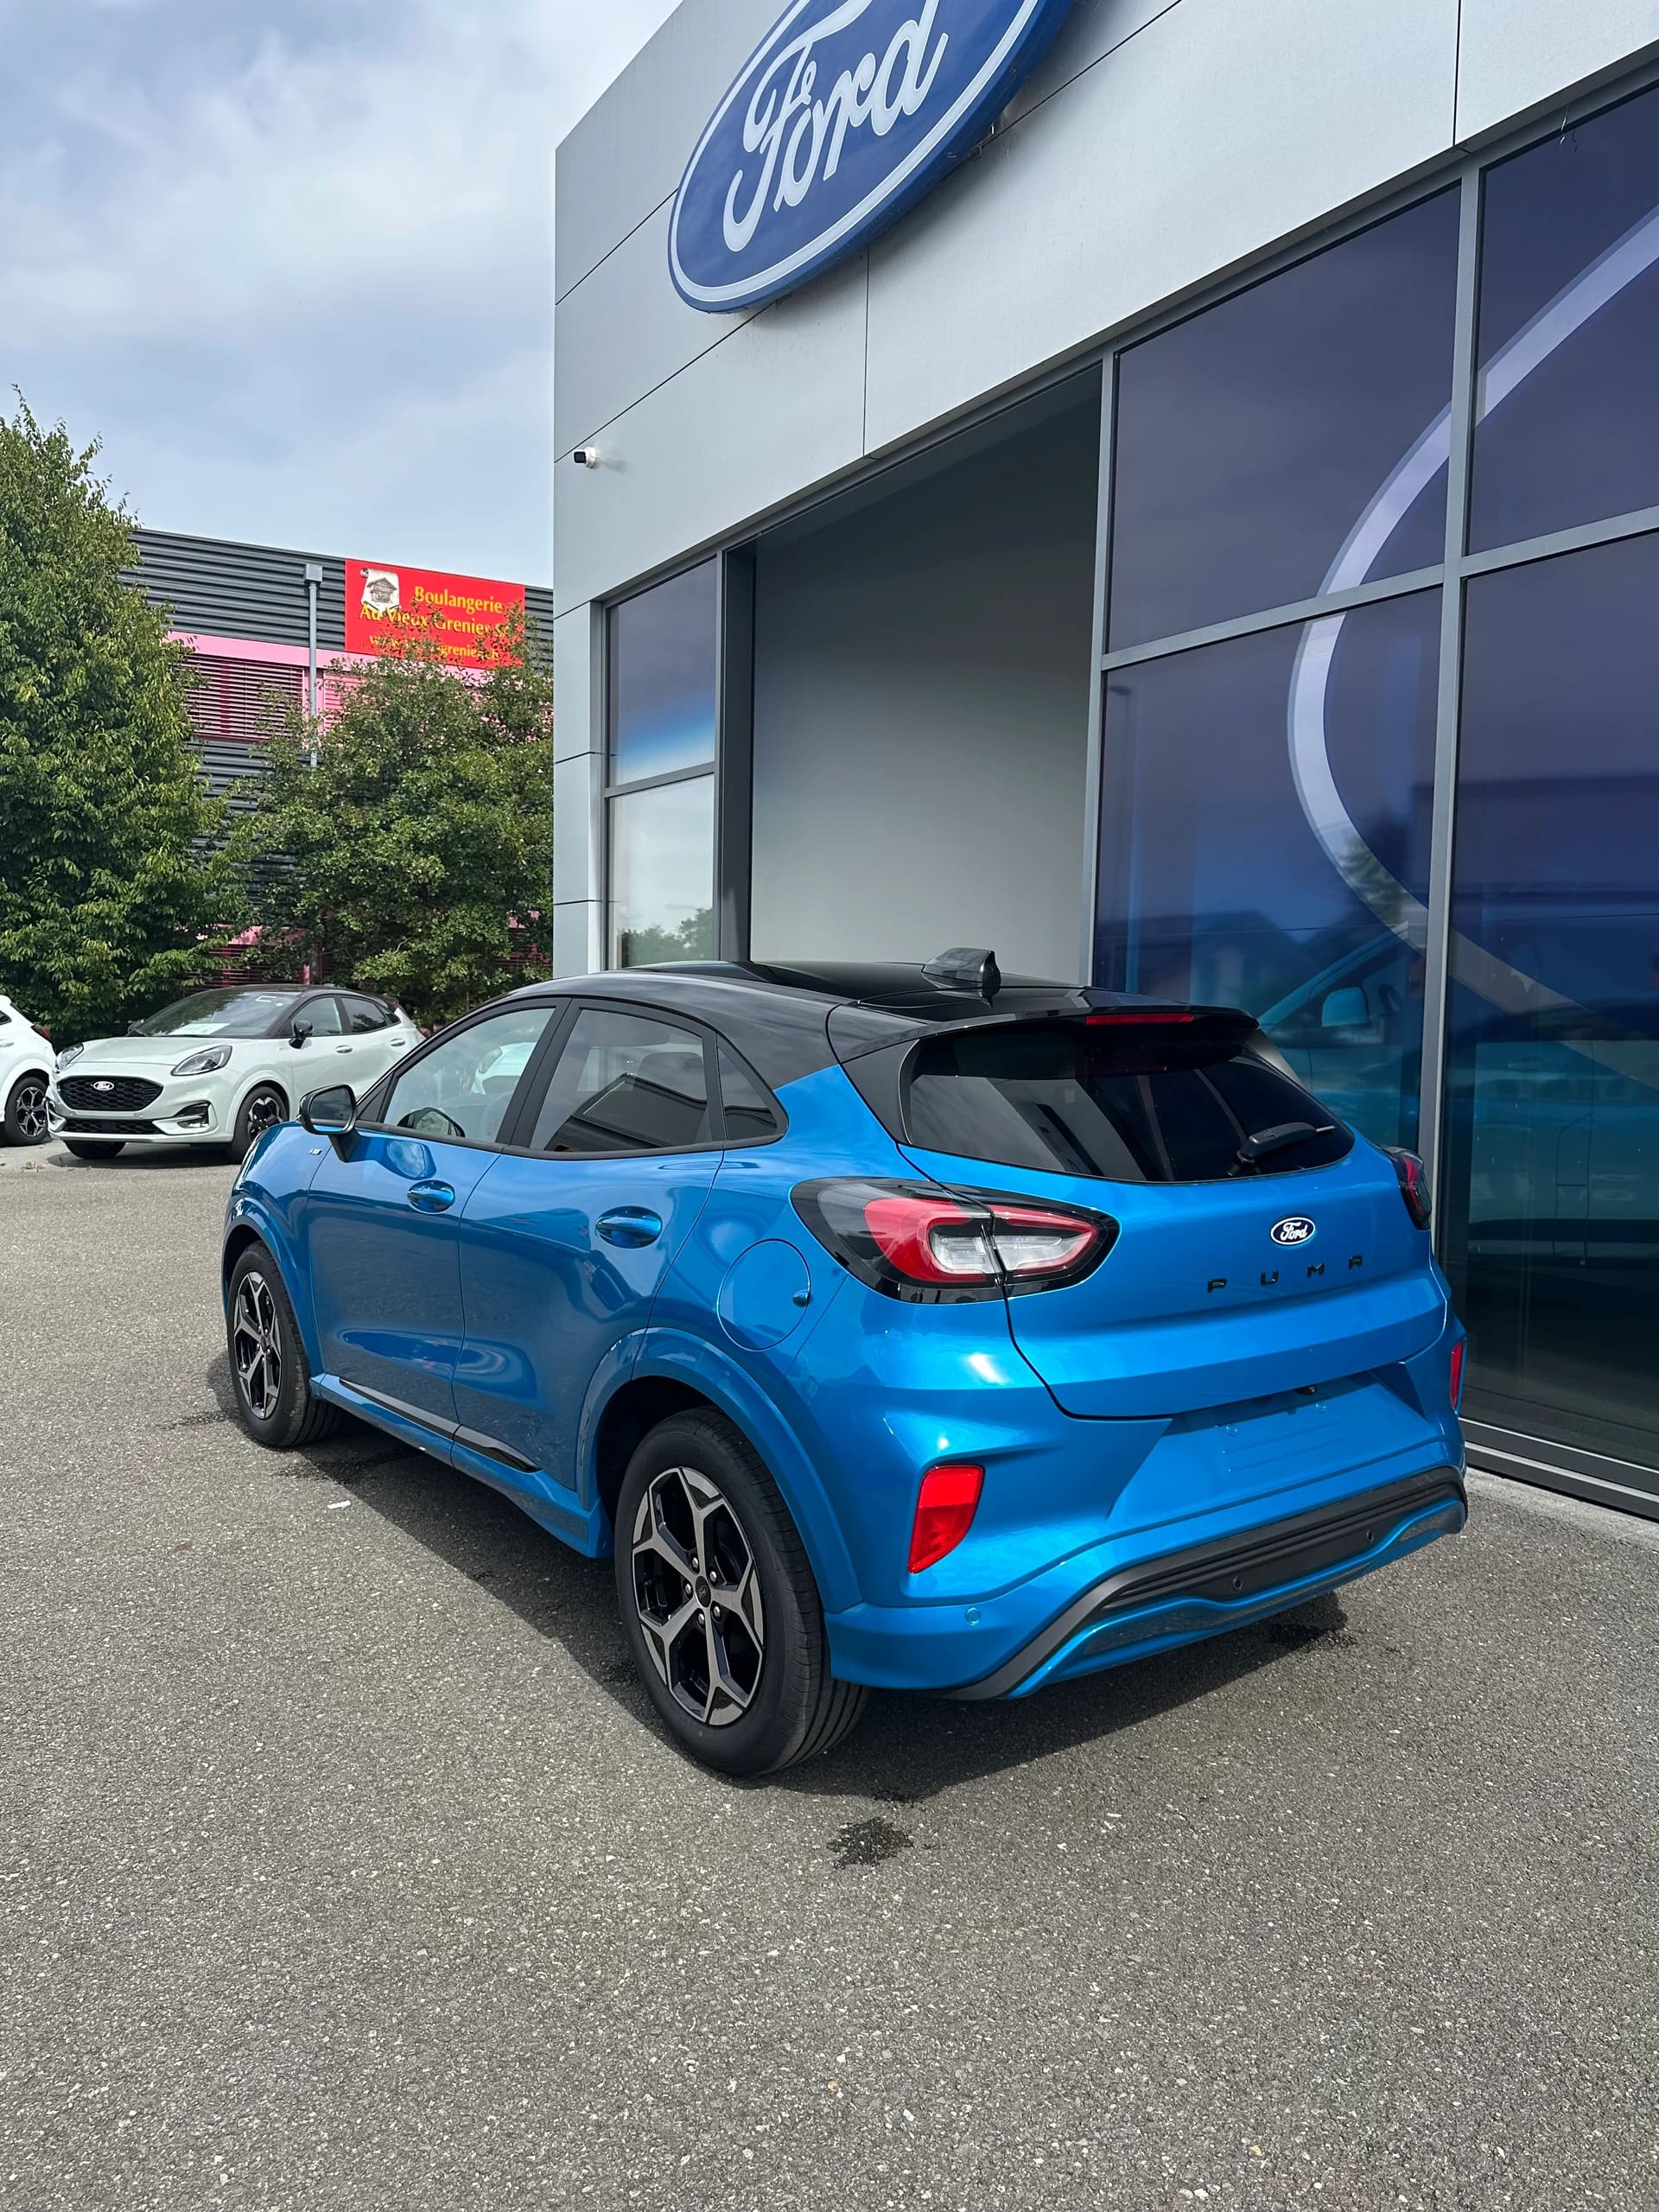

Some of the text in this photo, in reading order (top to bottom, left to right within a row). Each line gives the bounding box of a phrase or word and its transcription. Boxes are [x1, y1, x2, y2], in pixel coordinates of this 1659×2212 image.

[723, 0, 949, 251] Ford
[415, 585, 504, 614] Boulangerie
[359, 603, 380, 621] Au
[386, 607, 429, 628] Vieux
[1280, 1222, 1308, 1241] Ford
[1207, 1255, 1363, 1294] PUMA
